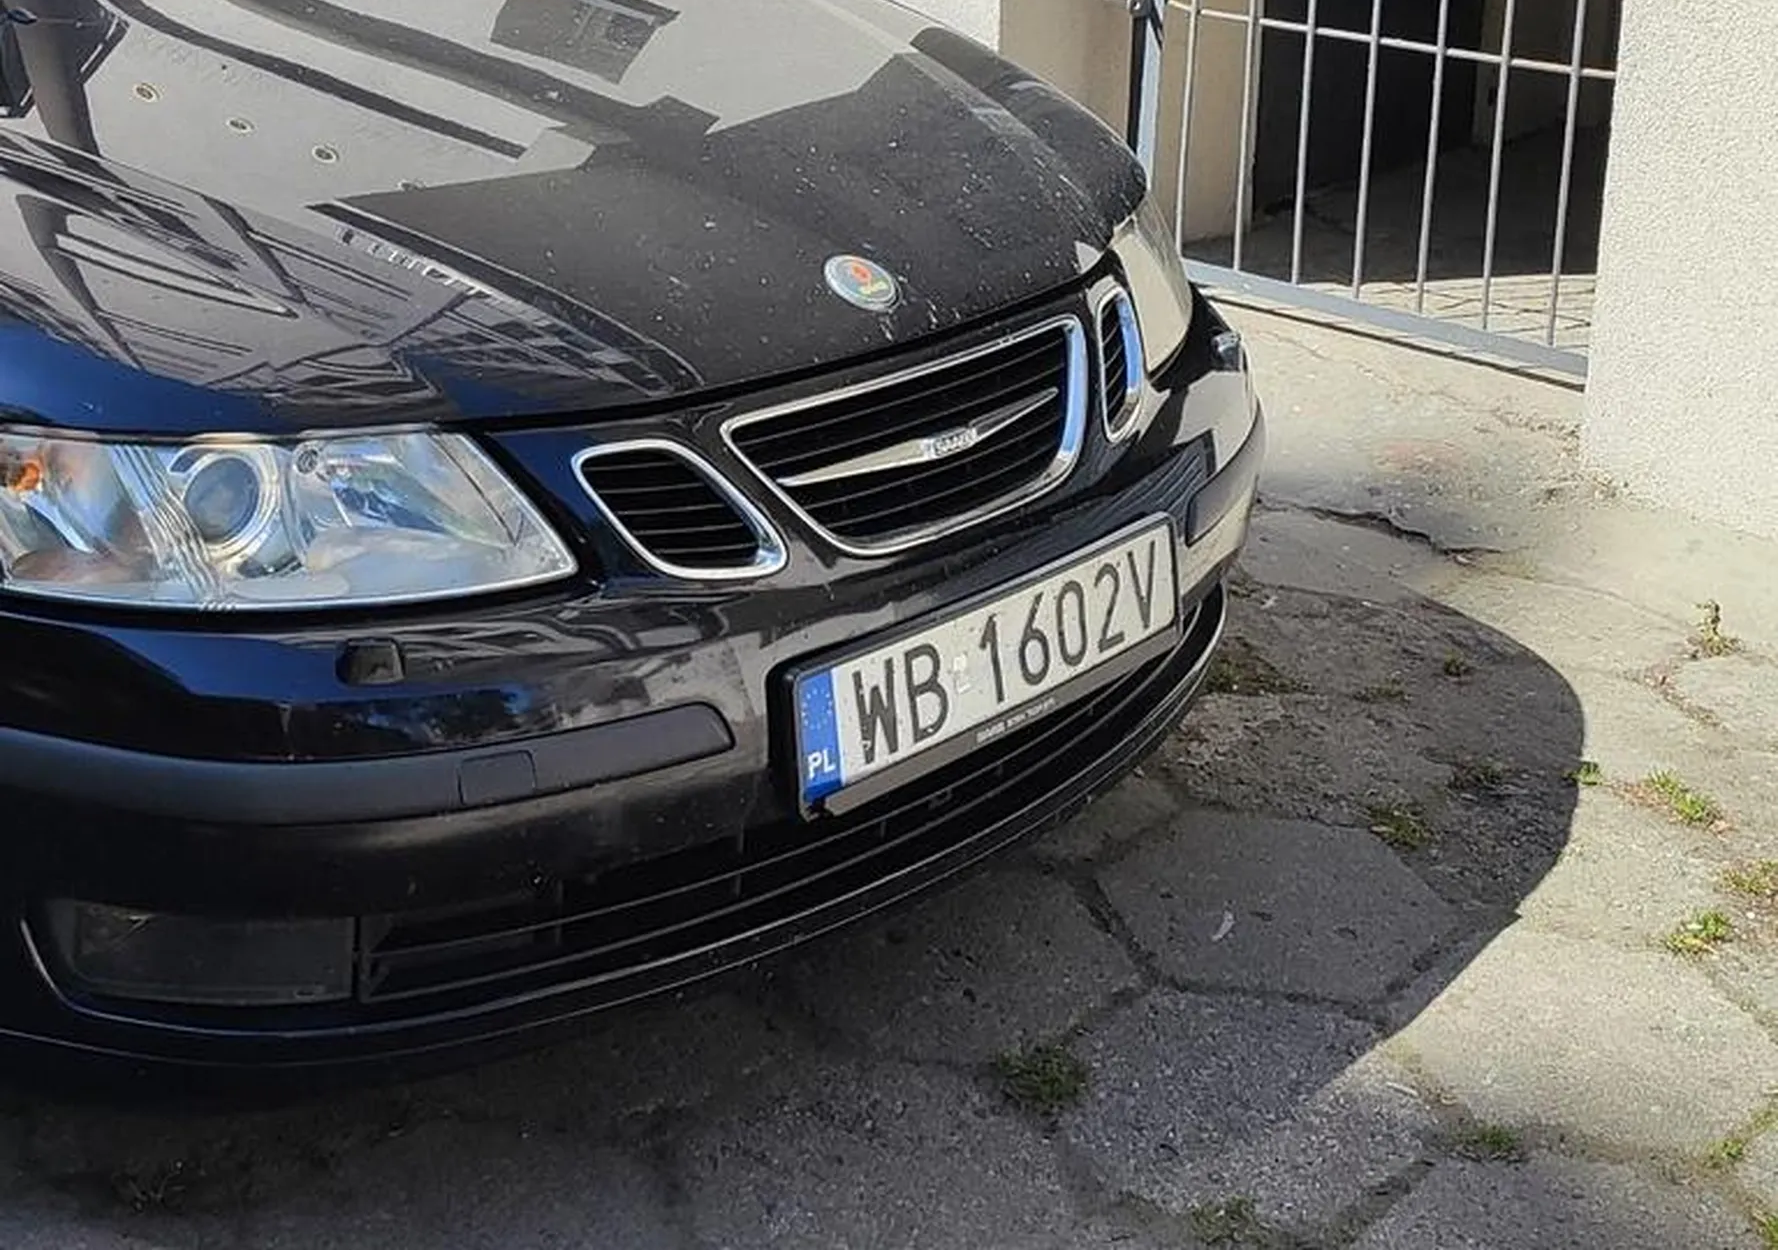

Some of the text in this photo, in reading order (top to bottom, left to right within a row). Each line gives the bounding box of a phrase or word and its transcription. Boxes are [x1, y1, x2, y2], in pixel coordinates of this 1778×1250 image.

[853, 541, 1156, 764] WB 1602V
[807, 752, 836, 780] PL
